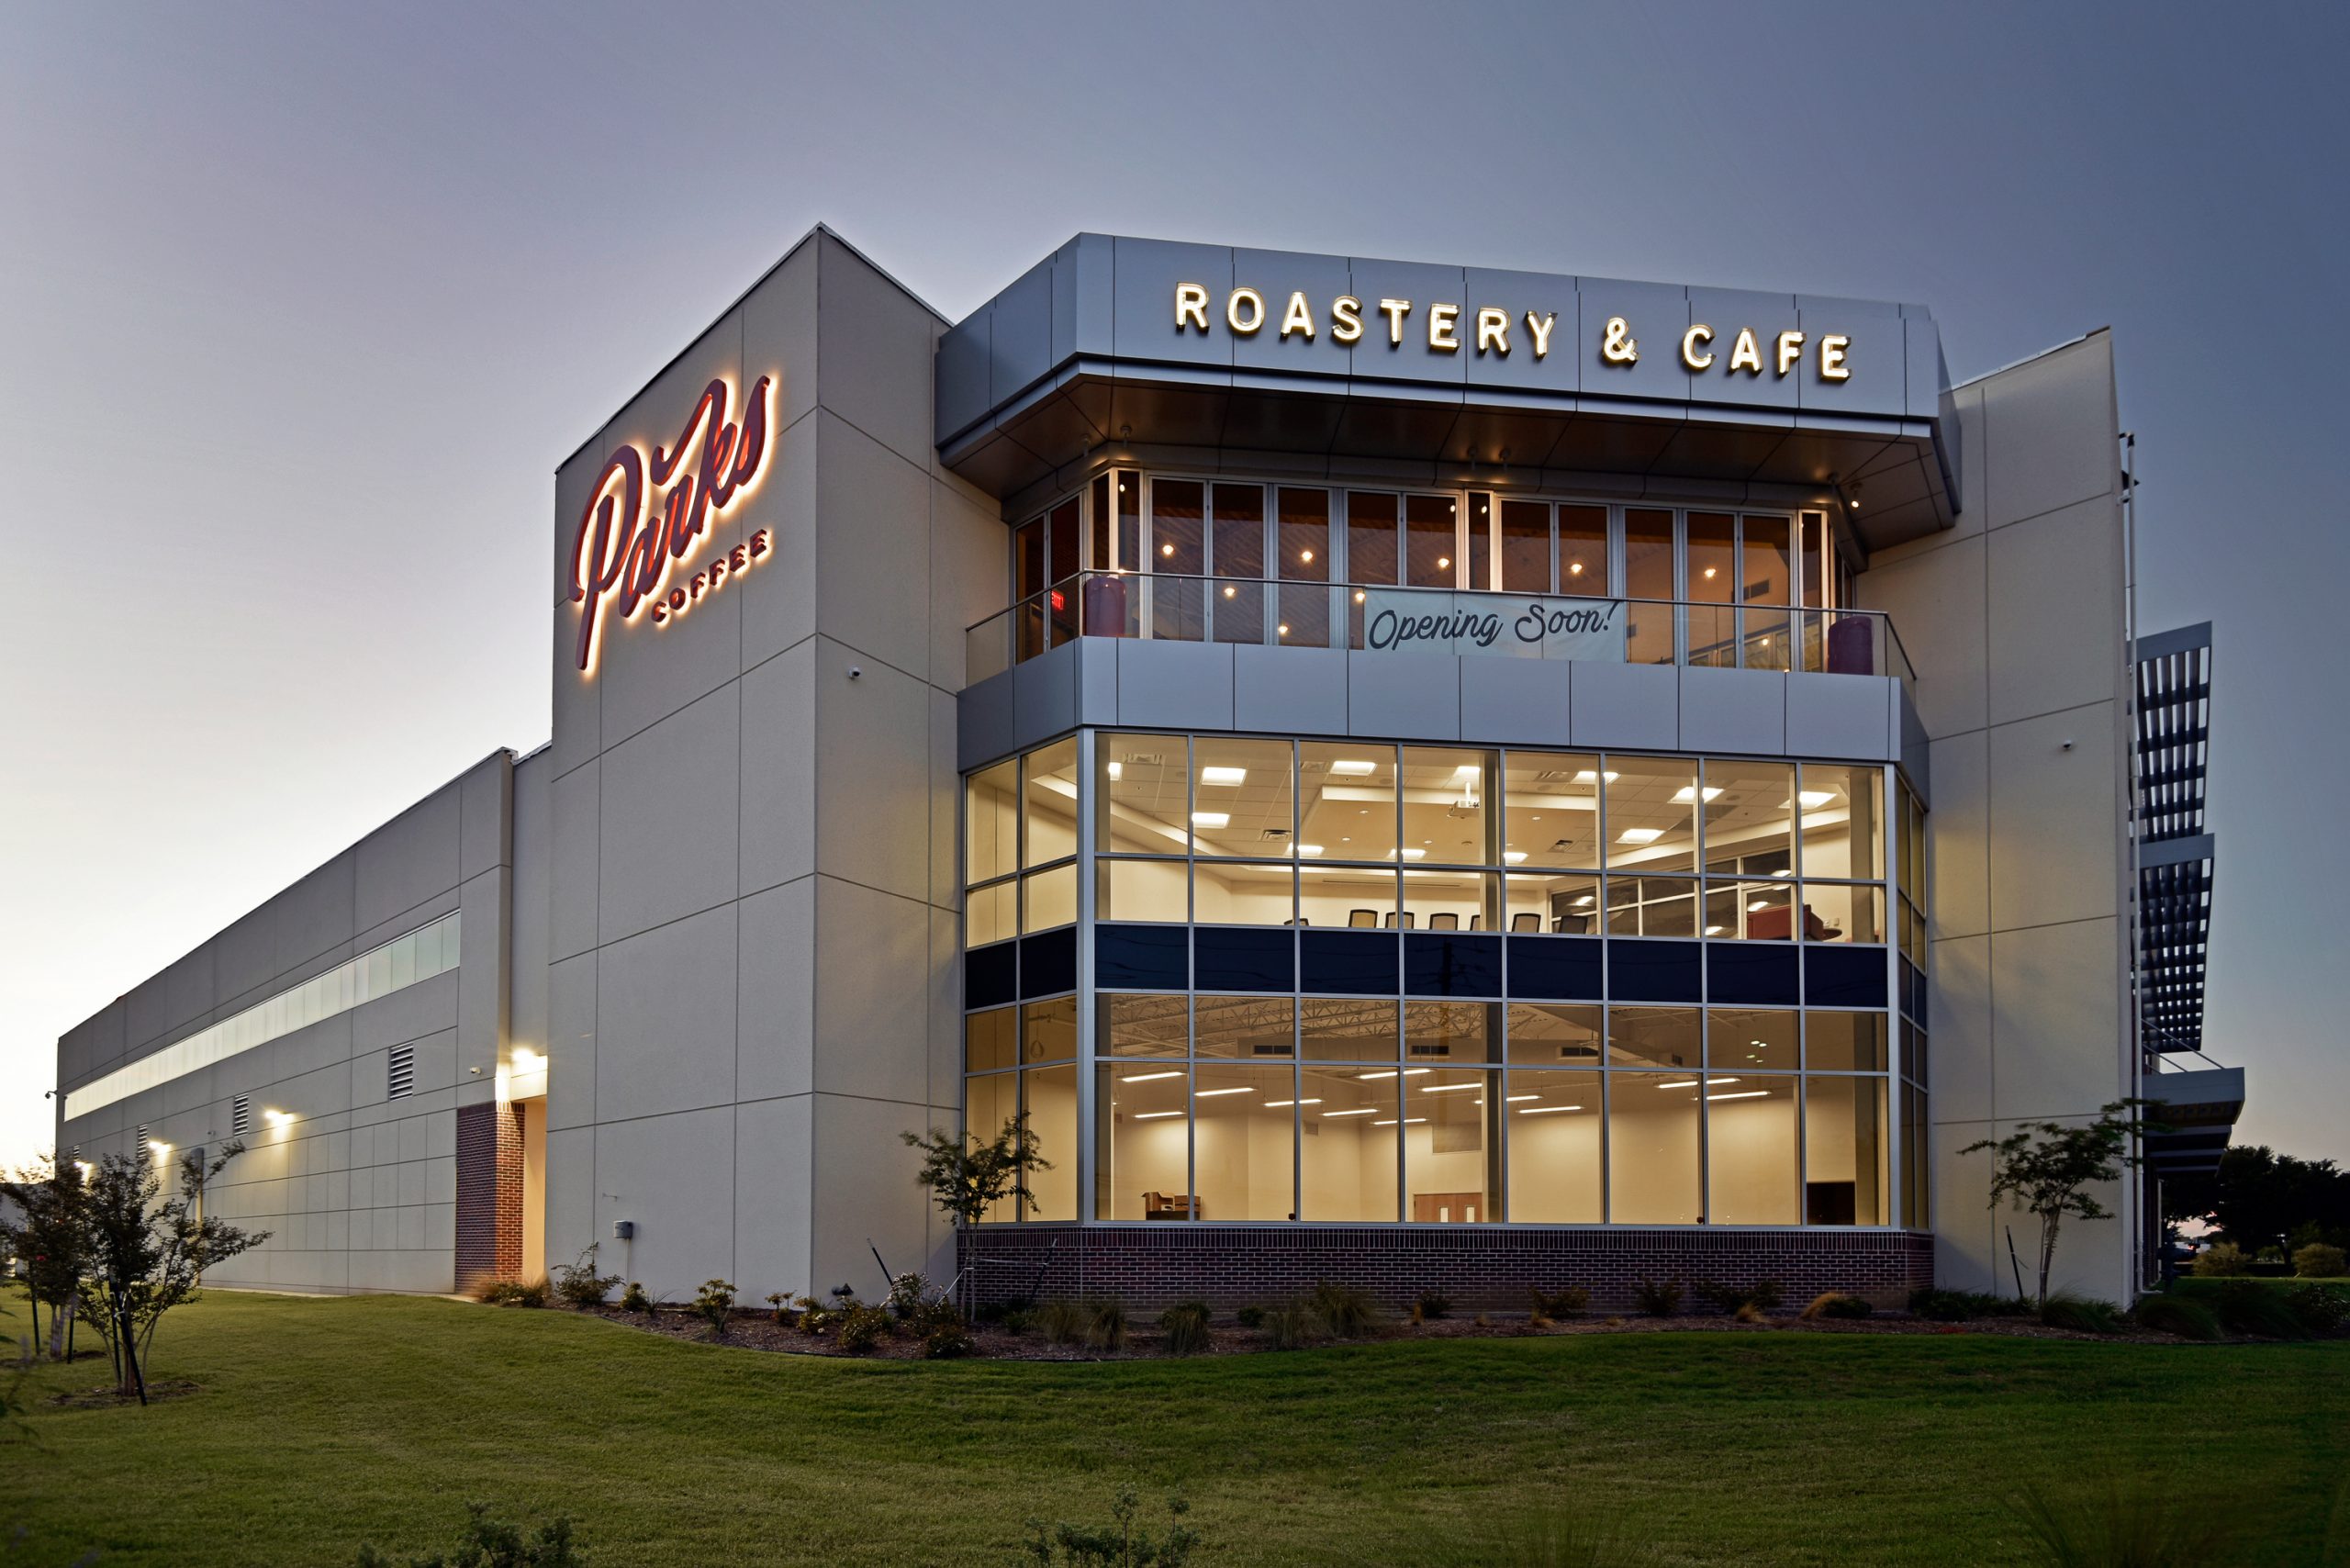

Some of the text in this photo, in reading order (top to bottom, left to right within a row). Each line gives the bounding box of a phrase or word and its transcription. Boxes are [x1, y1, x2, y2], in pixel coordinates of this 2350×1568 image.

[1175, 281, 1852, 382] ROASTERY & CAFE
[567, 375, 771, 671] Parks
[651, 528, 768, 623] COFFEE
[1368, 600, 1621, 651] Opening Soon!
